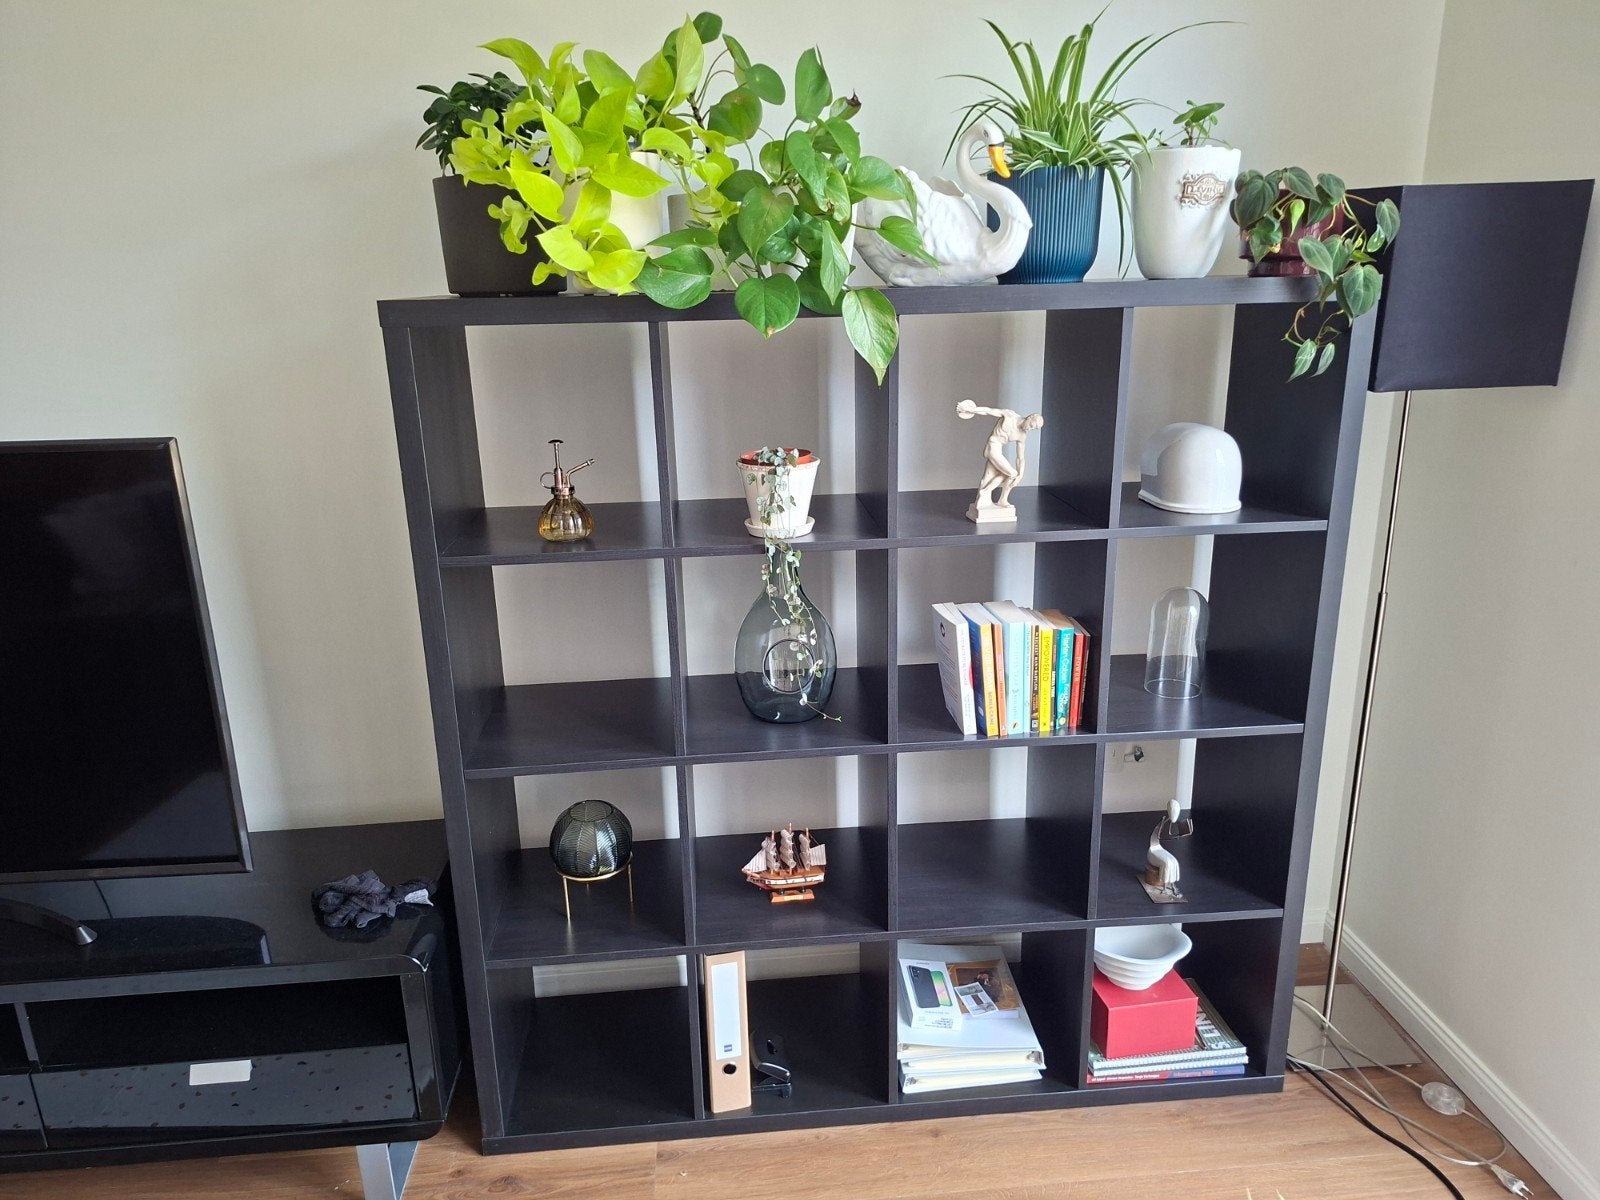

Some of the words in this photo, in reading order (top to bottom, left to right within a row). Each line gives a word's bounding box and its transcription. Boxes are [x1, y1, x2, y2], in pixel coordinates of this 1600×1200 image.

[1063, 634, 1071, 658] Harlan
[1042, 636, 1050, 681] EMPOWERED
[1062, 659, 1070, 683] Coben
